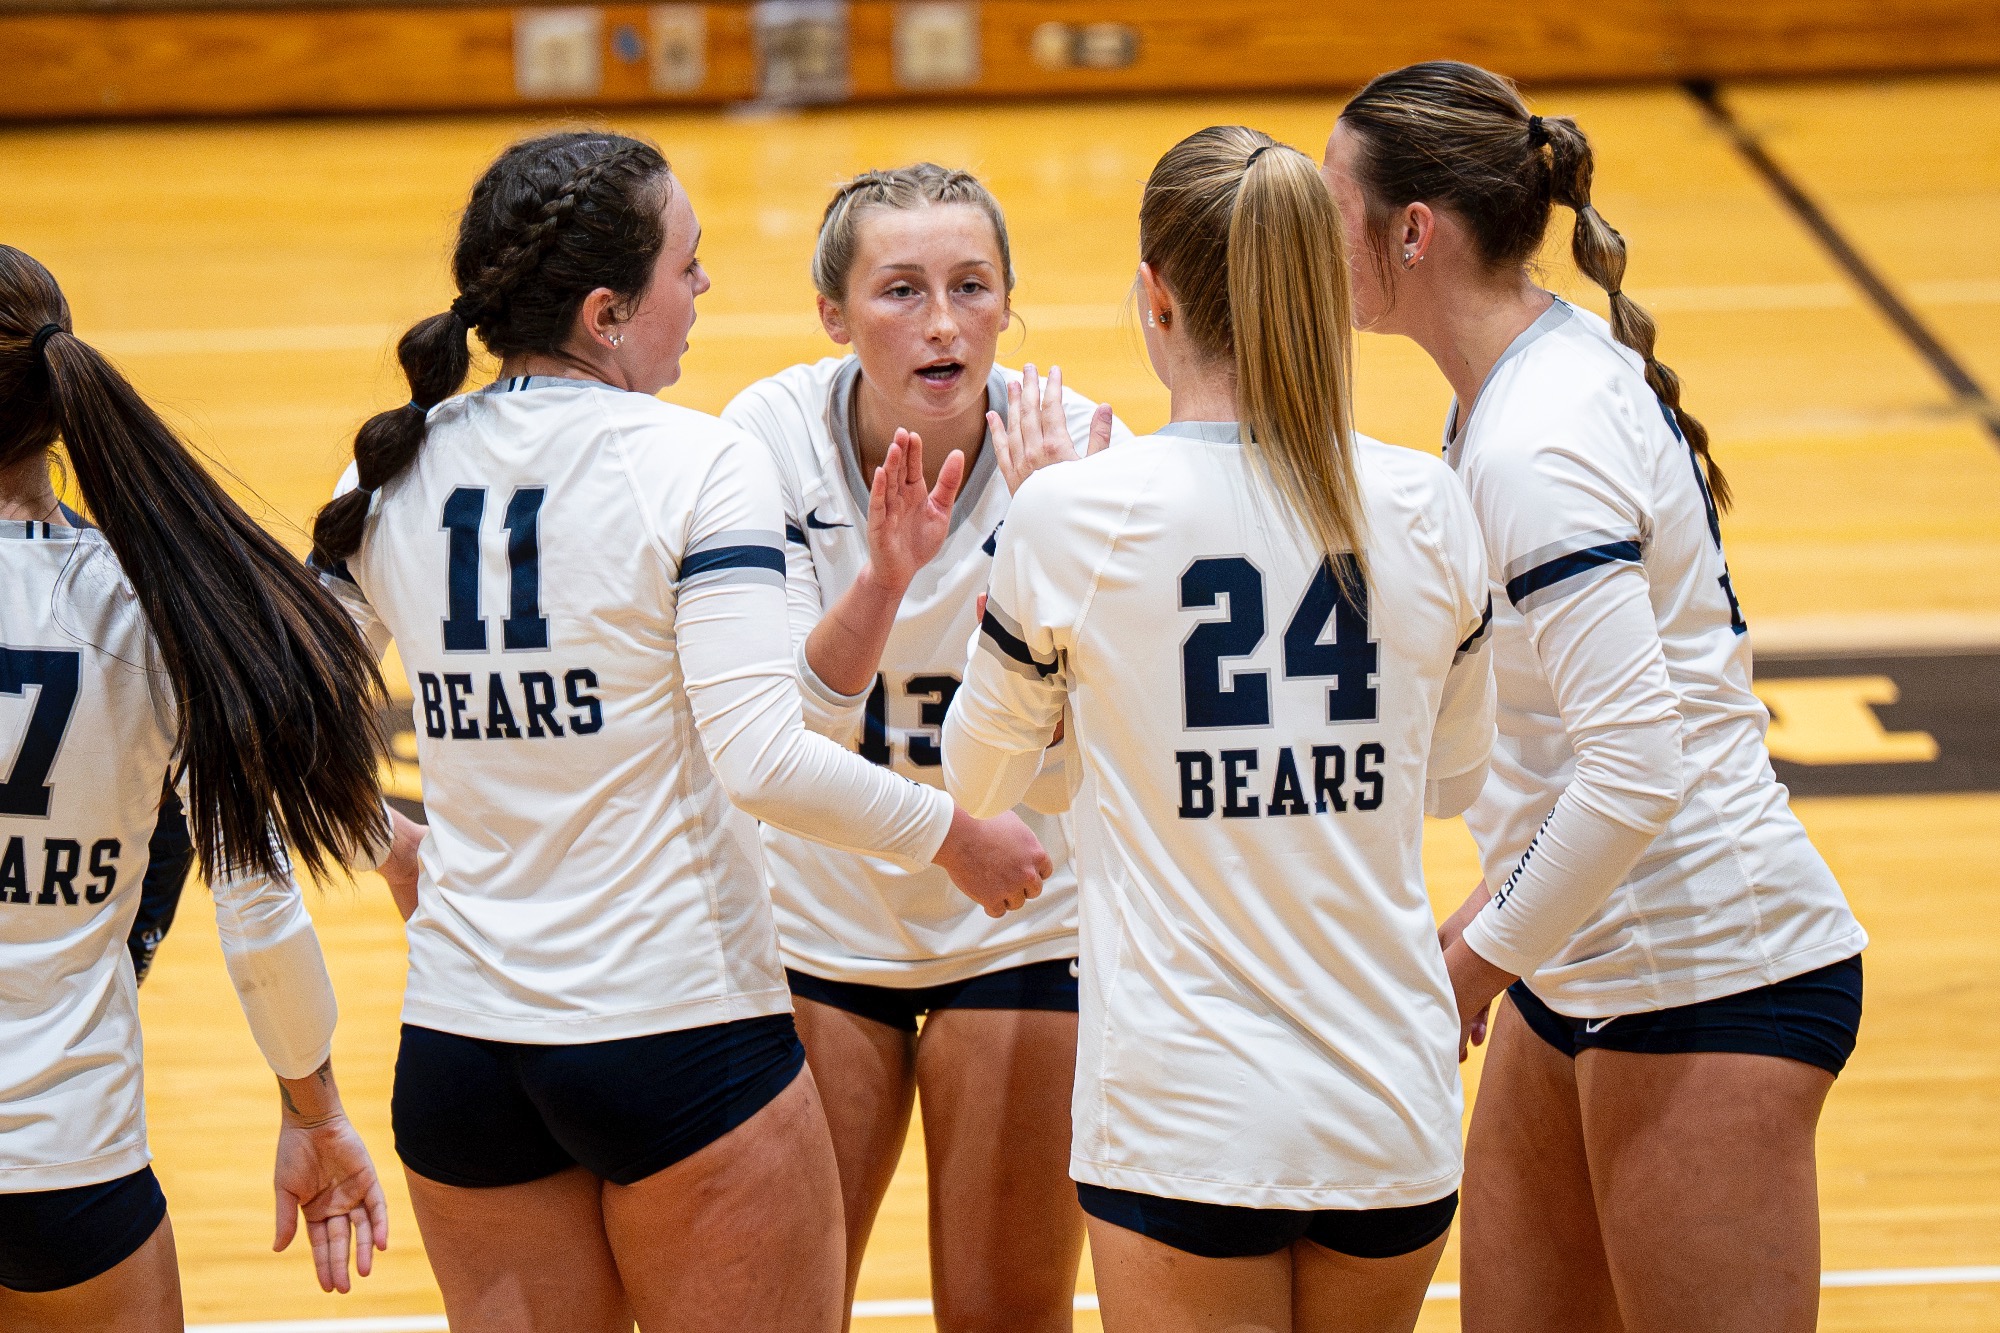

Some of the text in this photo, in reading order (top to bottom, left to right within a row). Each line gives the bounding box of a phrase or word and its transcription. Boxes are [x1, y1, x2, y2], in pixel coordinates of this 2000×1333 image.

[438, 484, 551, 655] 11
[1177, 550, 1381, 732] 24
[417, 667, 604, 740] BEARS
[857, 670, 963, 769] 13
[1174, 741, 1386, 819] BEARS
